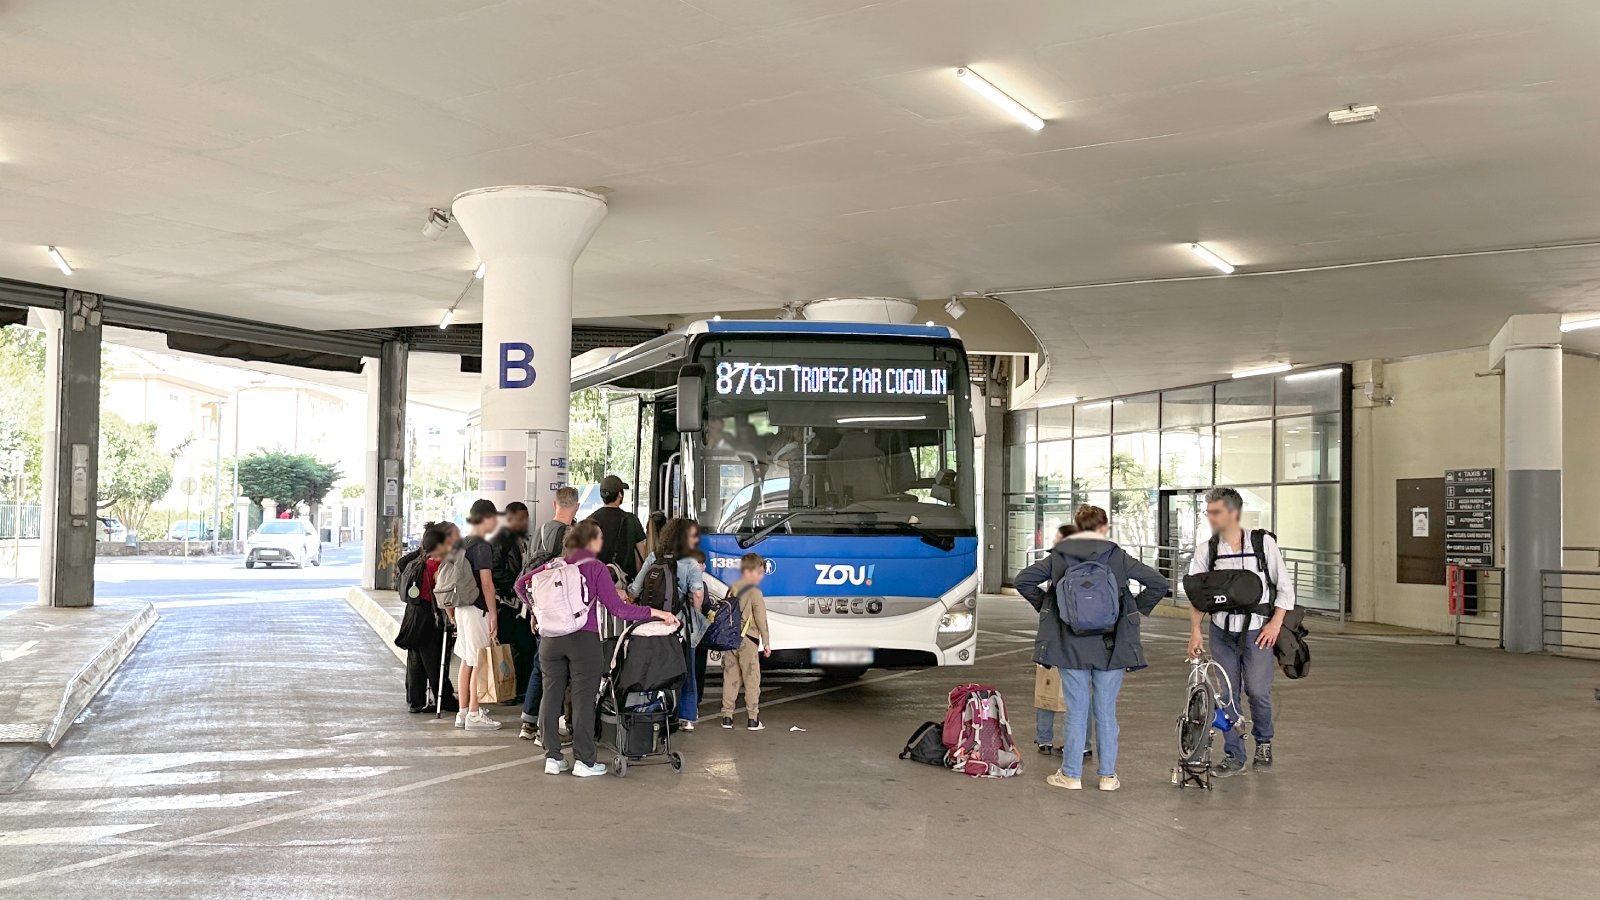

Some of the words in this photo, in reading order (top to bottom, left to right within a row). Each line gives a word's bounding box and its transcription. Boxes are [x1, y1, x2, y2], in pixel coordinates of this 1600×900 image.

[499, 342, 537, 389] B
[716, 362, 766, 395] 876
[793, 365, 849, 393] TROPEZ
[852, 367, 882, 394] PAR
[885, 368, 947, 395] COGOLIN
[815, 564, 875, 586] ZOU!
[807, 597, 883, 614] IVECO
